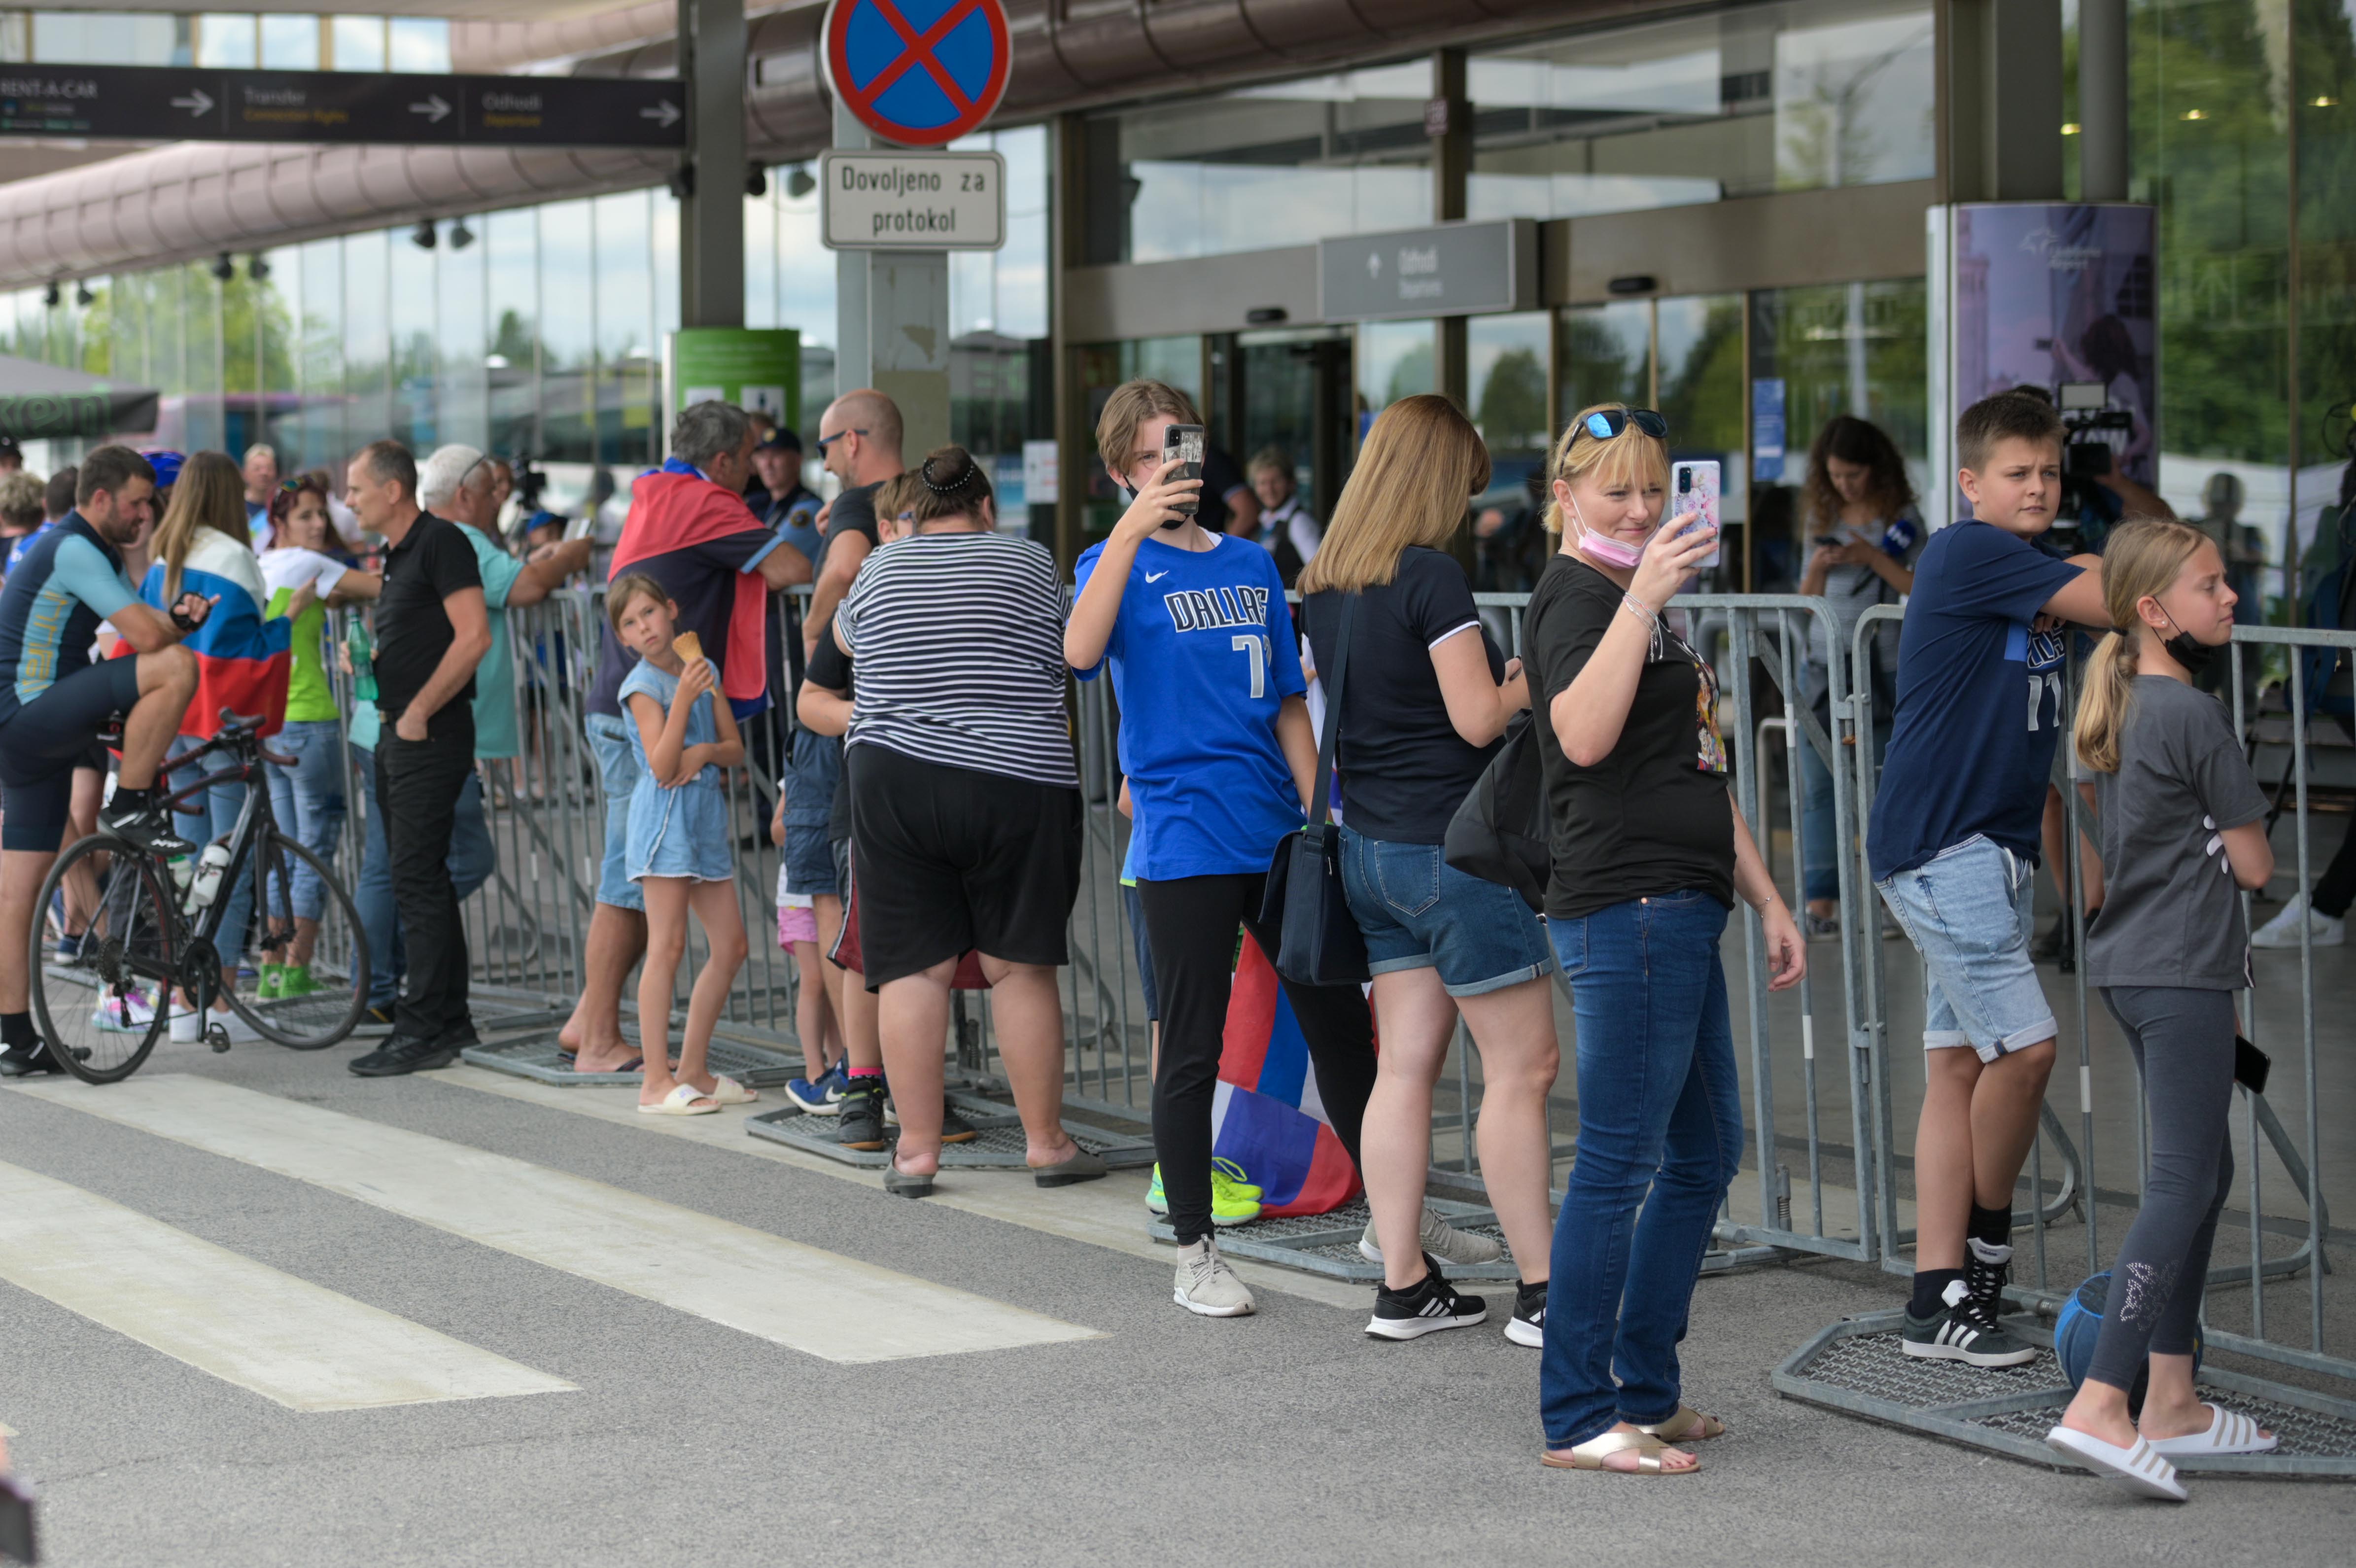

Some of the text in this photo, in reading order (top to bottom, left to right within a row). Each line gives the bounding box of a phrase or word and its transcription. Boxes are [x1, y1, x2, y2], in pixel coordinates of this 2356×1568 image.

[842, 165, 985, 197] Dovoljeno za
[873, 208, 955, 237] protokol
[1979, 1249, 1998, 1257] adidas
